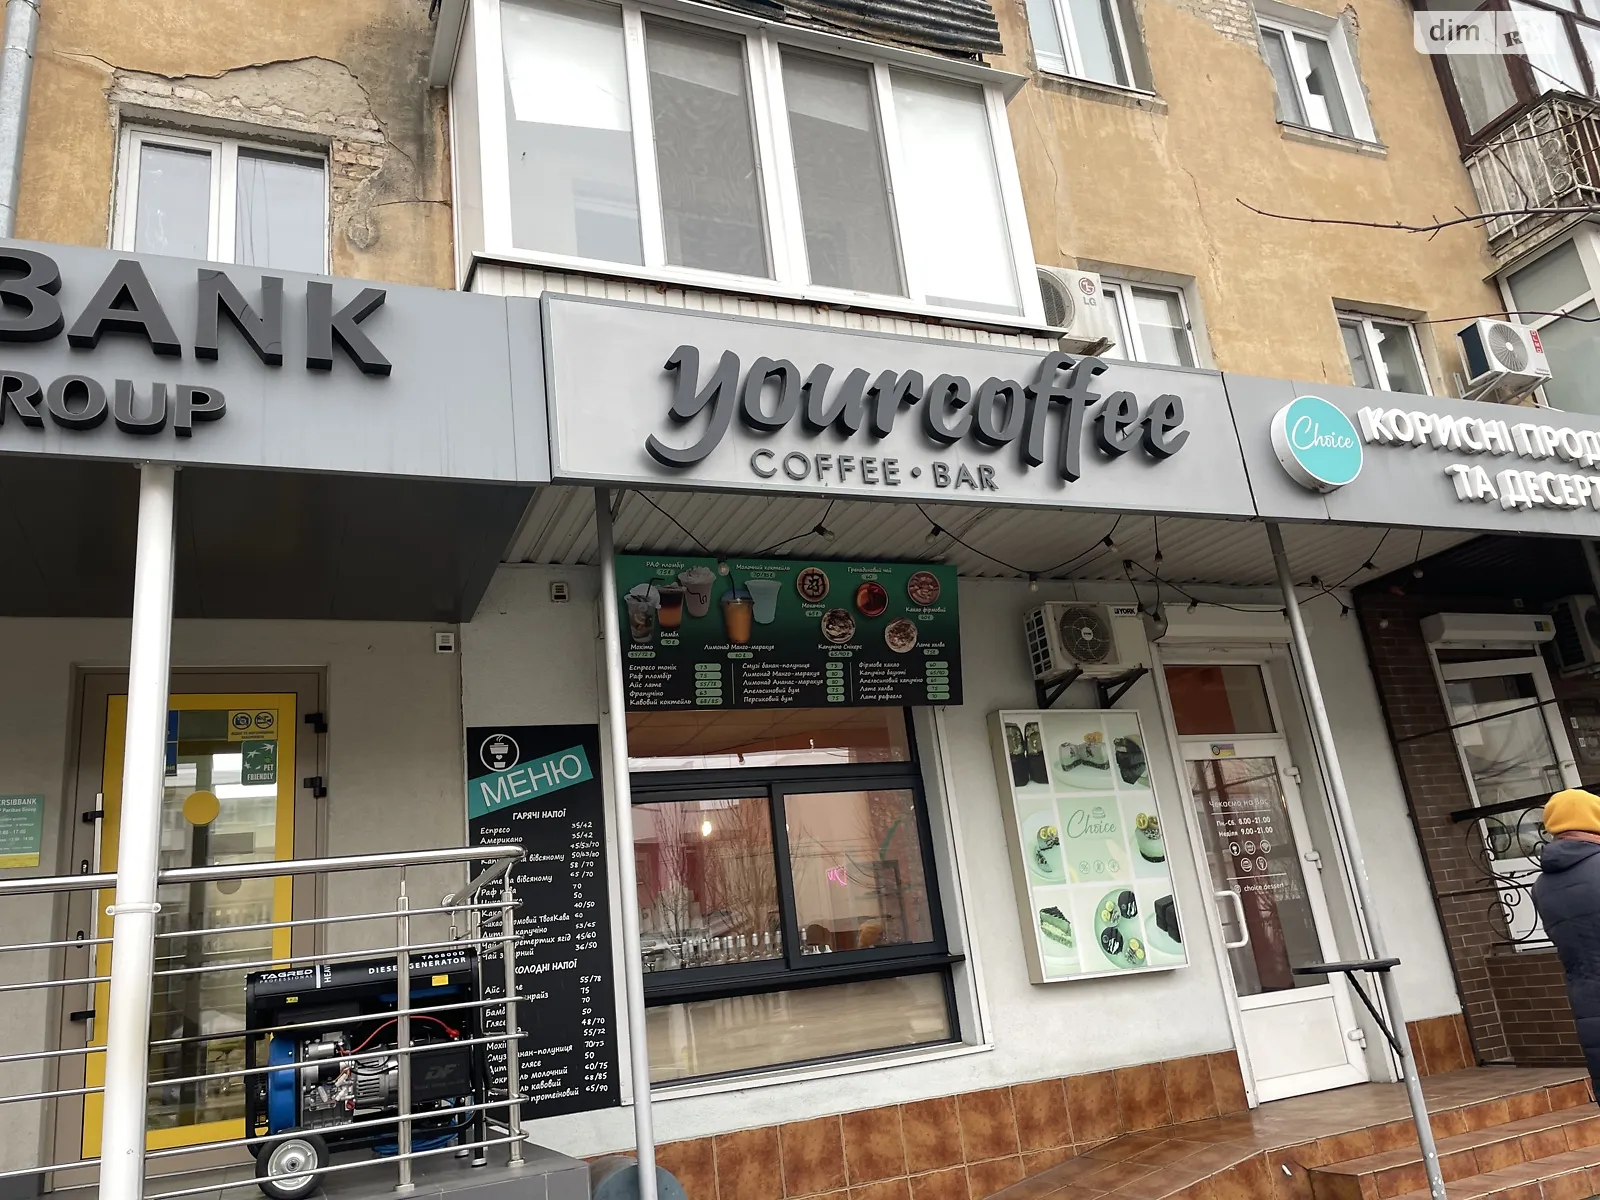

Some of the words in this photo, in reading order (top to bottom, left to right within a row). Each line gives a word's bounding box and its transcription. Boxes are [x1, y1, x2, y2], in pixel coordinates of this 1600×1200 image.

[1082, 296, 1098, 307] LG
[645, 344, 1190, 483] yourcoffee
[1292, 415, 1354, 450] Choice
[1357, 406, 1515, 455] КОРИСНІ
[750, 447, 902, 485] COFFEE
[933, 462, 999, 491] BAR
[1445, 464, 1498, 503] ТА
[628, 664, 656, 673] Еспресо
[657, 663, 678, 671] тонік
[742, 662, 760, 671] Смузі
[628, 672, 644, 681] Раф
[644, 672, 673, 681] пломбір
[771, 670, 821, 678] Манго-маракуя
[628, 681, 643, 689] Айс
[742, 678, 771, 686] Лимонад
[629, 698, 658, 706] Кавовий
[659, 698, 692, 706] коктейль
[247, 773, 274, 781] FRIENDLY
[480, 754, 582, 806] МЕНЮ
[512, 811, 540, 821] ГАРЯЧІ
[541, 808, 567, 819] НАПОЇ
[480, 827, 511, 836] Еспресо
[571, 821, 593, 829] 35/42
[1066, 810, 1116, 838] Choice
[479, 836, 523, 845] Американо
[571, 831, 593, 839] 35/42
[529, 853, 565, 862] вівсяному
[516, 875, 553, 884] вівсяному
[480, 887, 497, 898] Раф
[574, 901, 596, 909] 40/50
[538, 914, 570, 923] ТвояКава
[515, 926, 548, 937] капучіно
[557, 933, 572, 943] ягід
[575, 931, 597, 940] 45/60
[481, 952, 497, 961] Чай
[575, 941, 598, 951] 36/50
[368, 964, 399, 975] DIESE
[552, 958, 578, 970] НАПОЇ
[259, 974, 313, 984] PROFESSIONAL
[260, 969, 313, 980] TAGRED
[484, 985, 501, 995] Айс
[579, 974, 602, 983] 55/78
[580, 986, 590, 994] 75
[581, 1017, 605, 1026] 48/70
[583, 1027, 606, 1036] 55/72
[521, 1060, 542, 1069] глясе
[584, 1051, 595, 1059] 50
[530, 1066, 568, 1080] молочний
[584, 1061, 608, 1070] 60/75
[531, 1078, 562, 1090] кавовий
[584, 1072, 608, 1081] 68/85
[585, 1084, 609, 1092] 65/90
